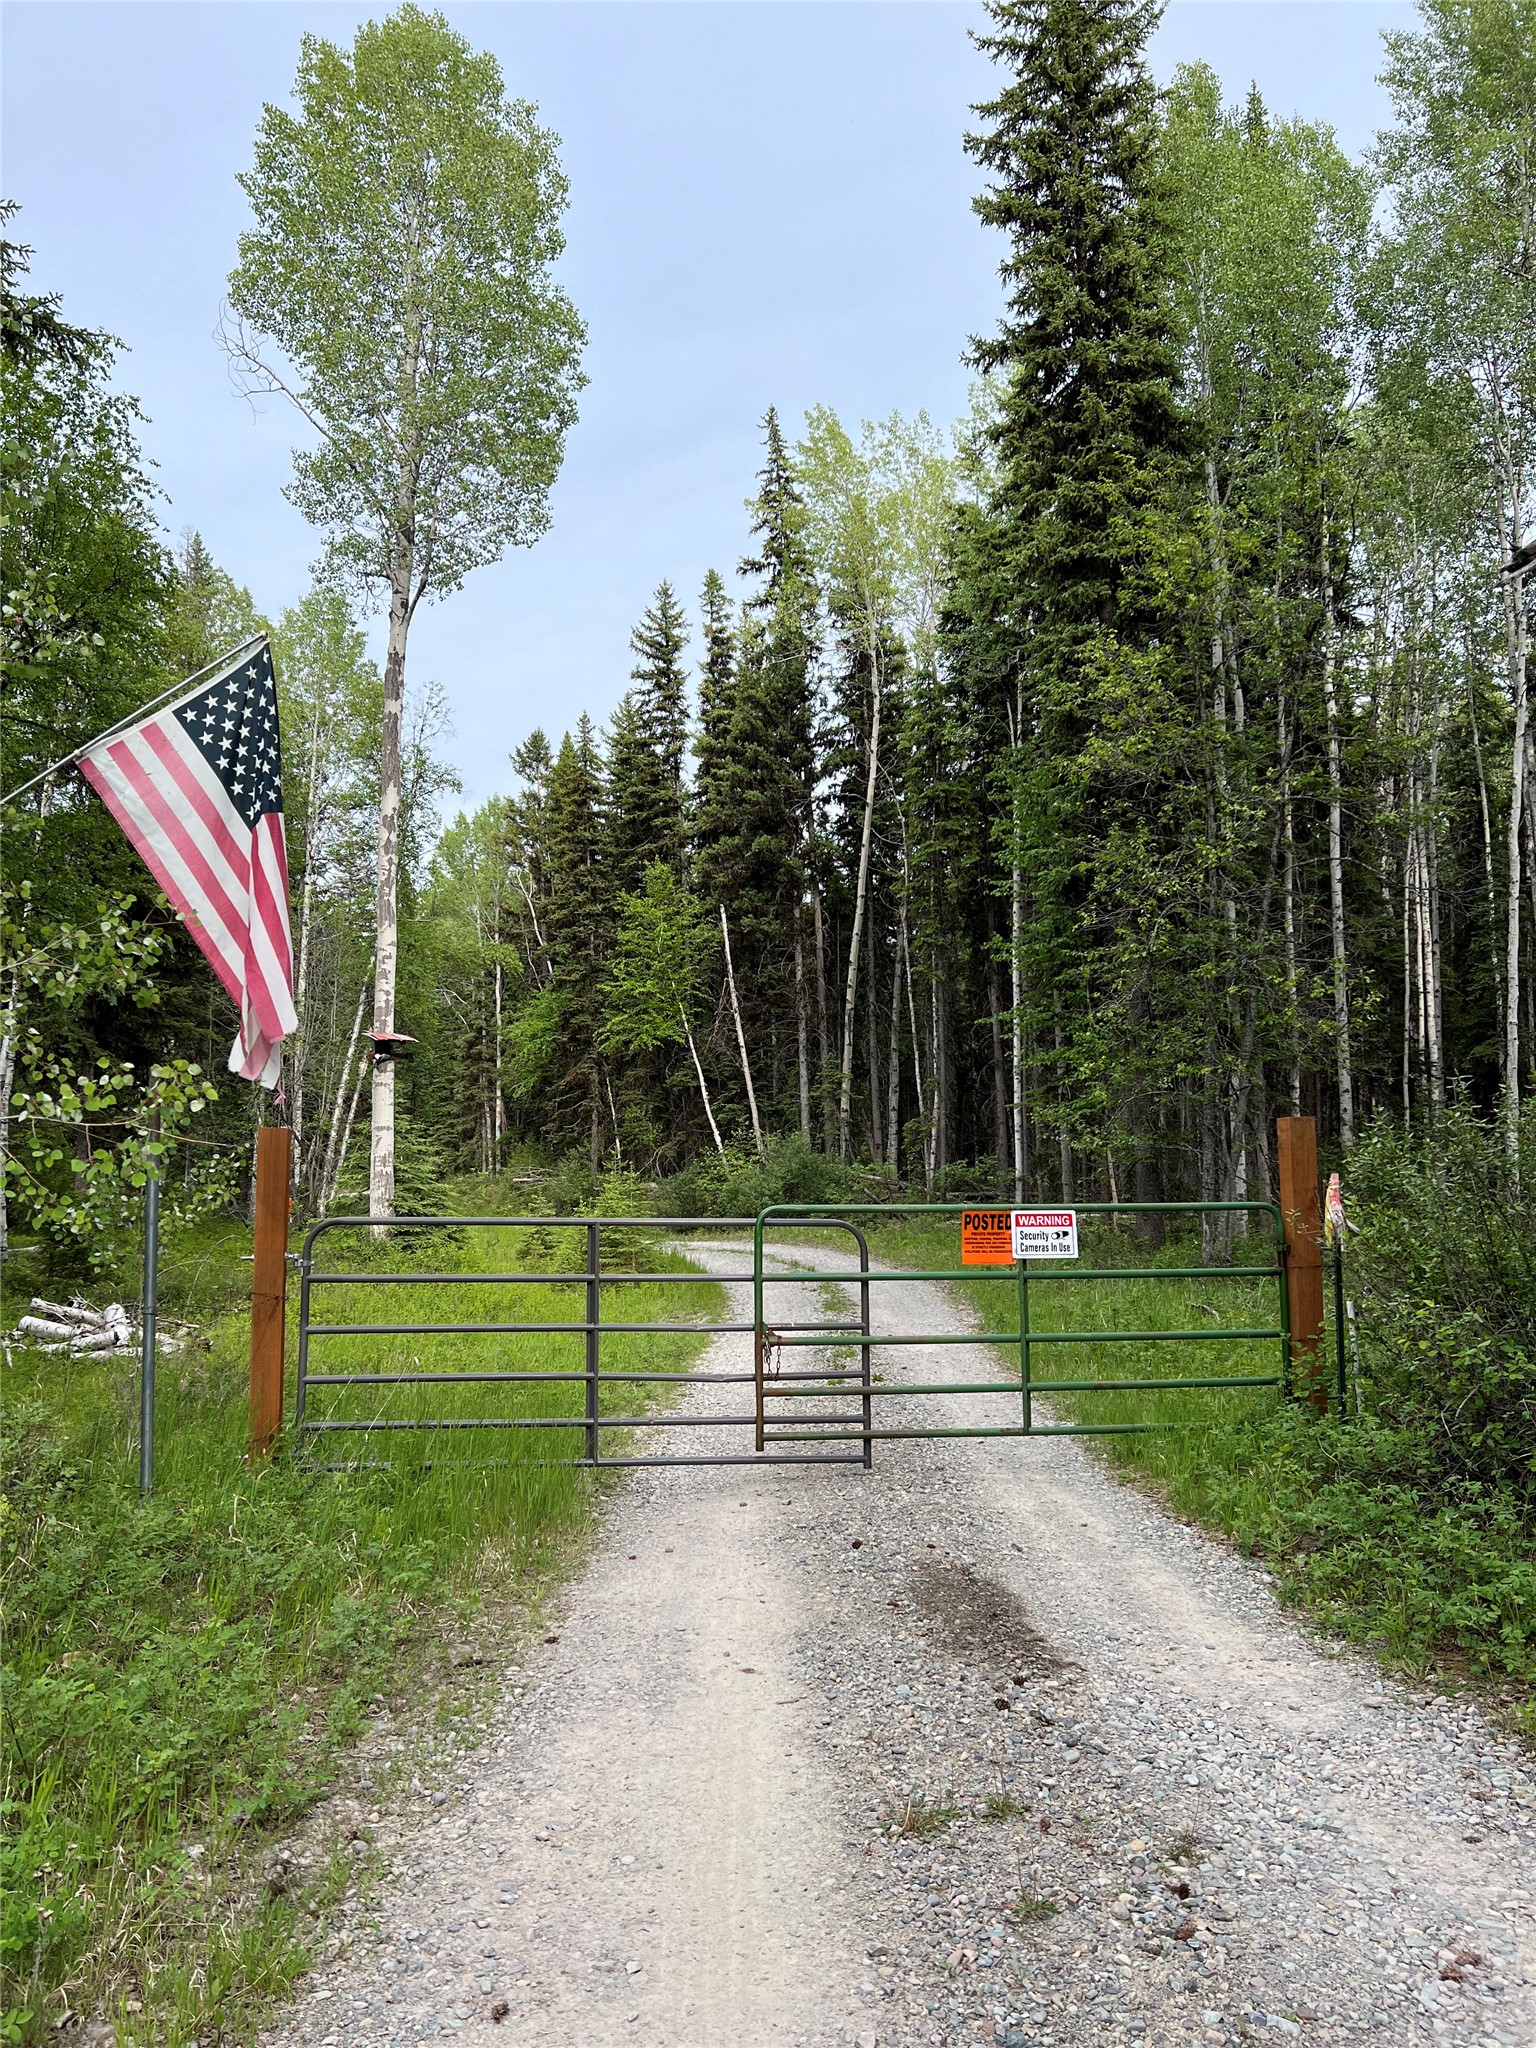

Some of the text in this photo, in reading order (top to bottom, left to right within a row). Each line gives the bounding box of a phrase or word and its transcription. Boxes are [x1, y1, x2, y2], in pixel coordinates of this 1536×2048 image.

[964, 1213, 1011, 1230] POSTED
[1017, 1215, 1070, 1226] WARNING
[1019, 1230, 1049, 1242] Security
[1020, 1242, 1071, 1252] Cameras In Use
